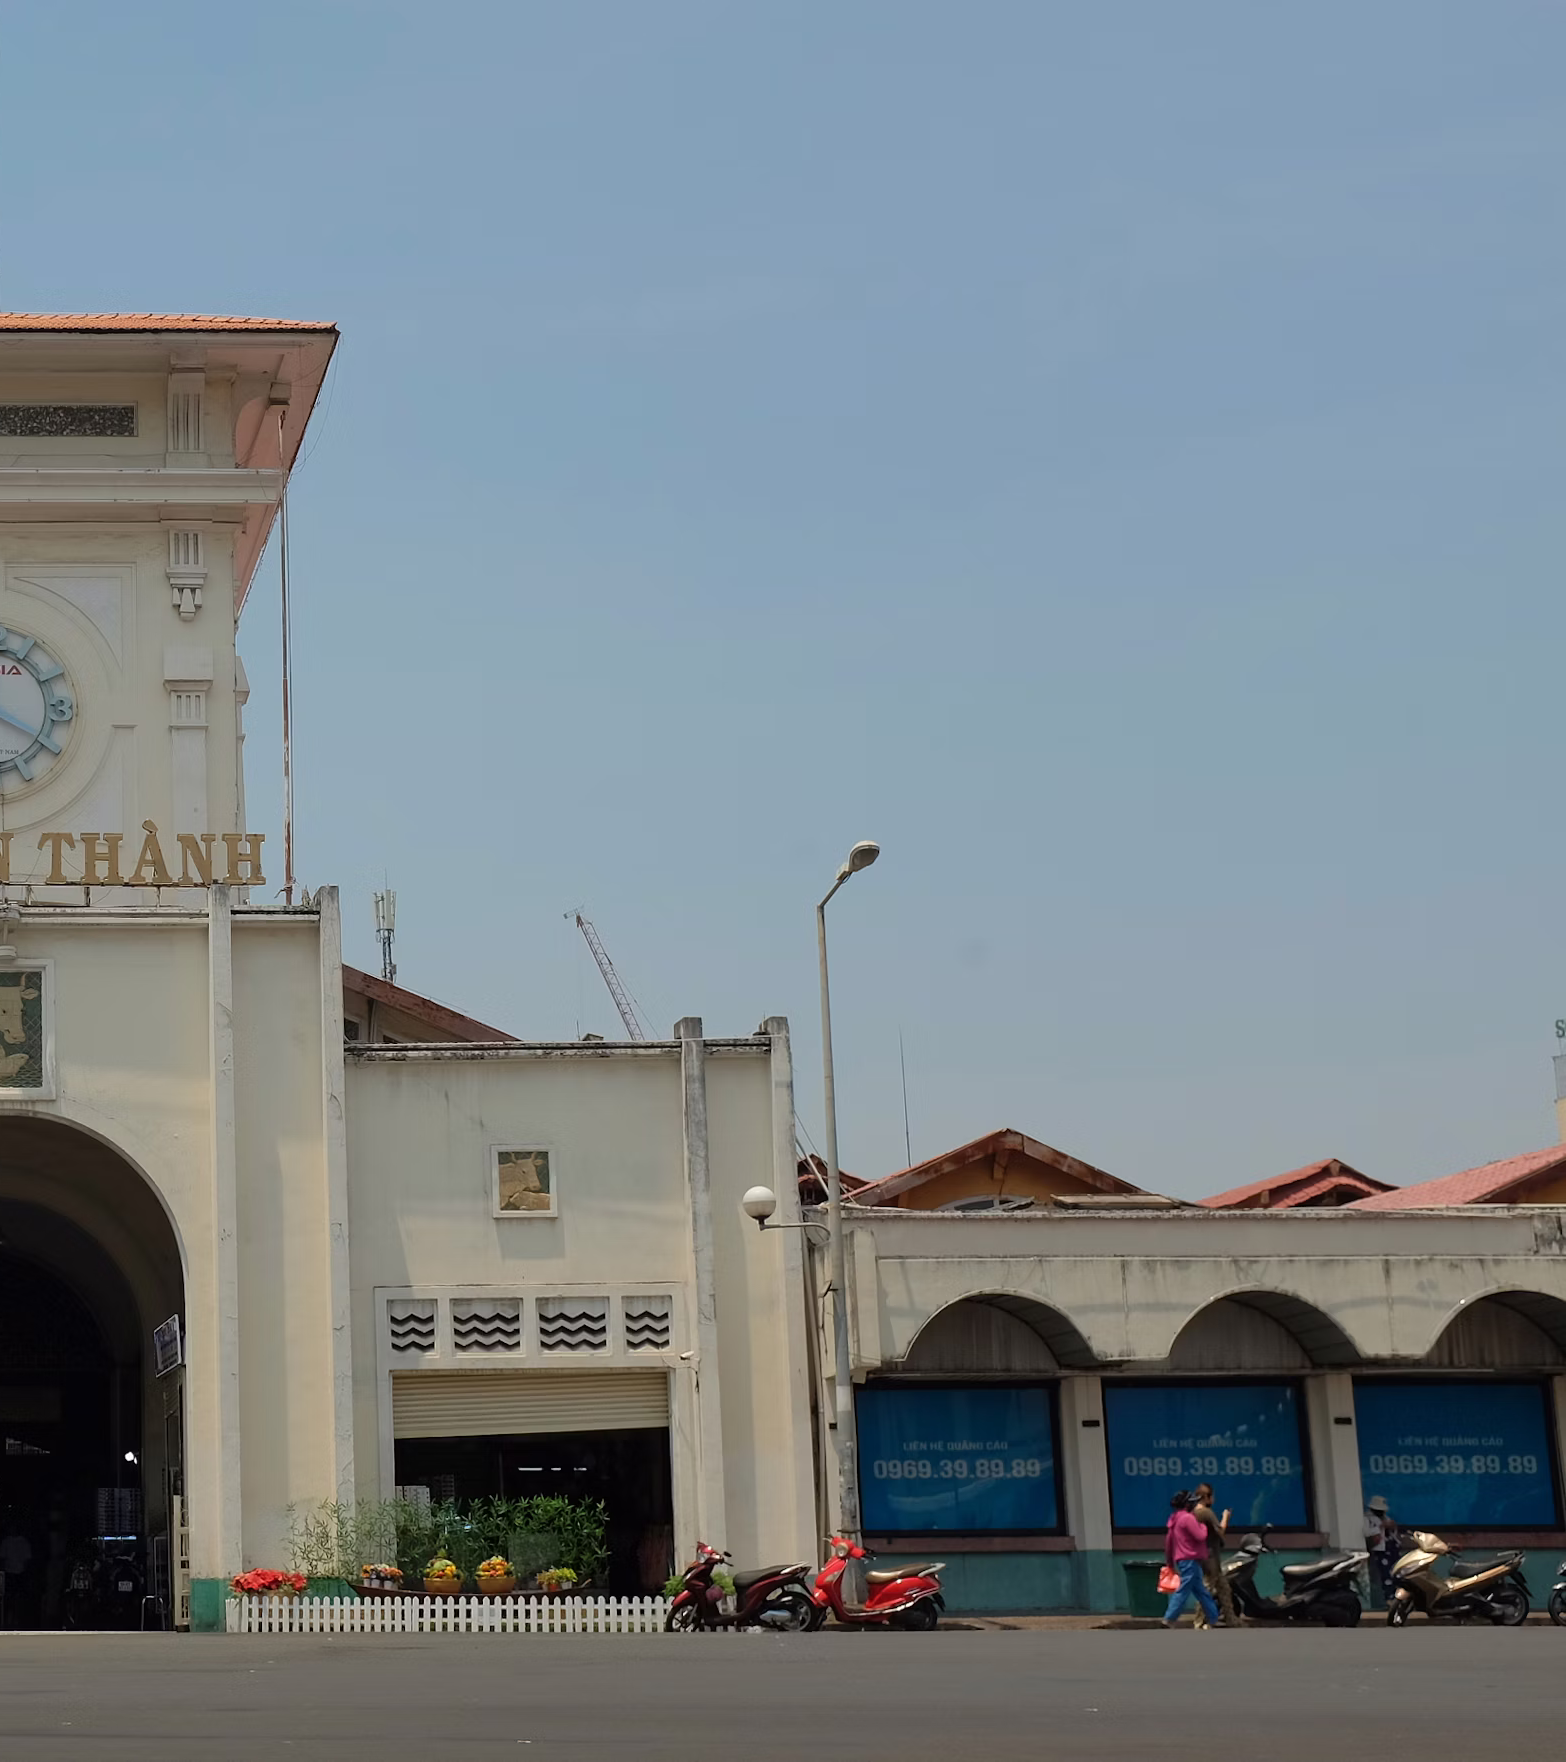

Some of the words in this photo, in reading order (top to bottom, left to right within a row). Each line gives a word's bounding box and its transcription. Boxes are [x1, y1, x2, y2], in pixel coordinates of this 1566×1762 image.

[48, 695, 73, 722] 3
[38, 818, 267, 885] THÀNH
[873, 1459, 1041, 1479] 0969.39.89.89
[1124, 1456, 1291, 1476] 0969.39.89.89
[1369, 1454, 1537, 1474] 0969.39.89.89
